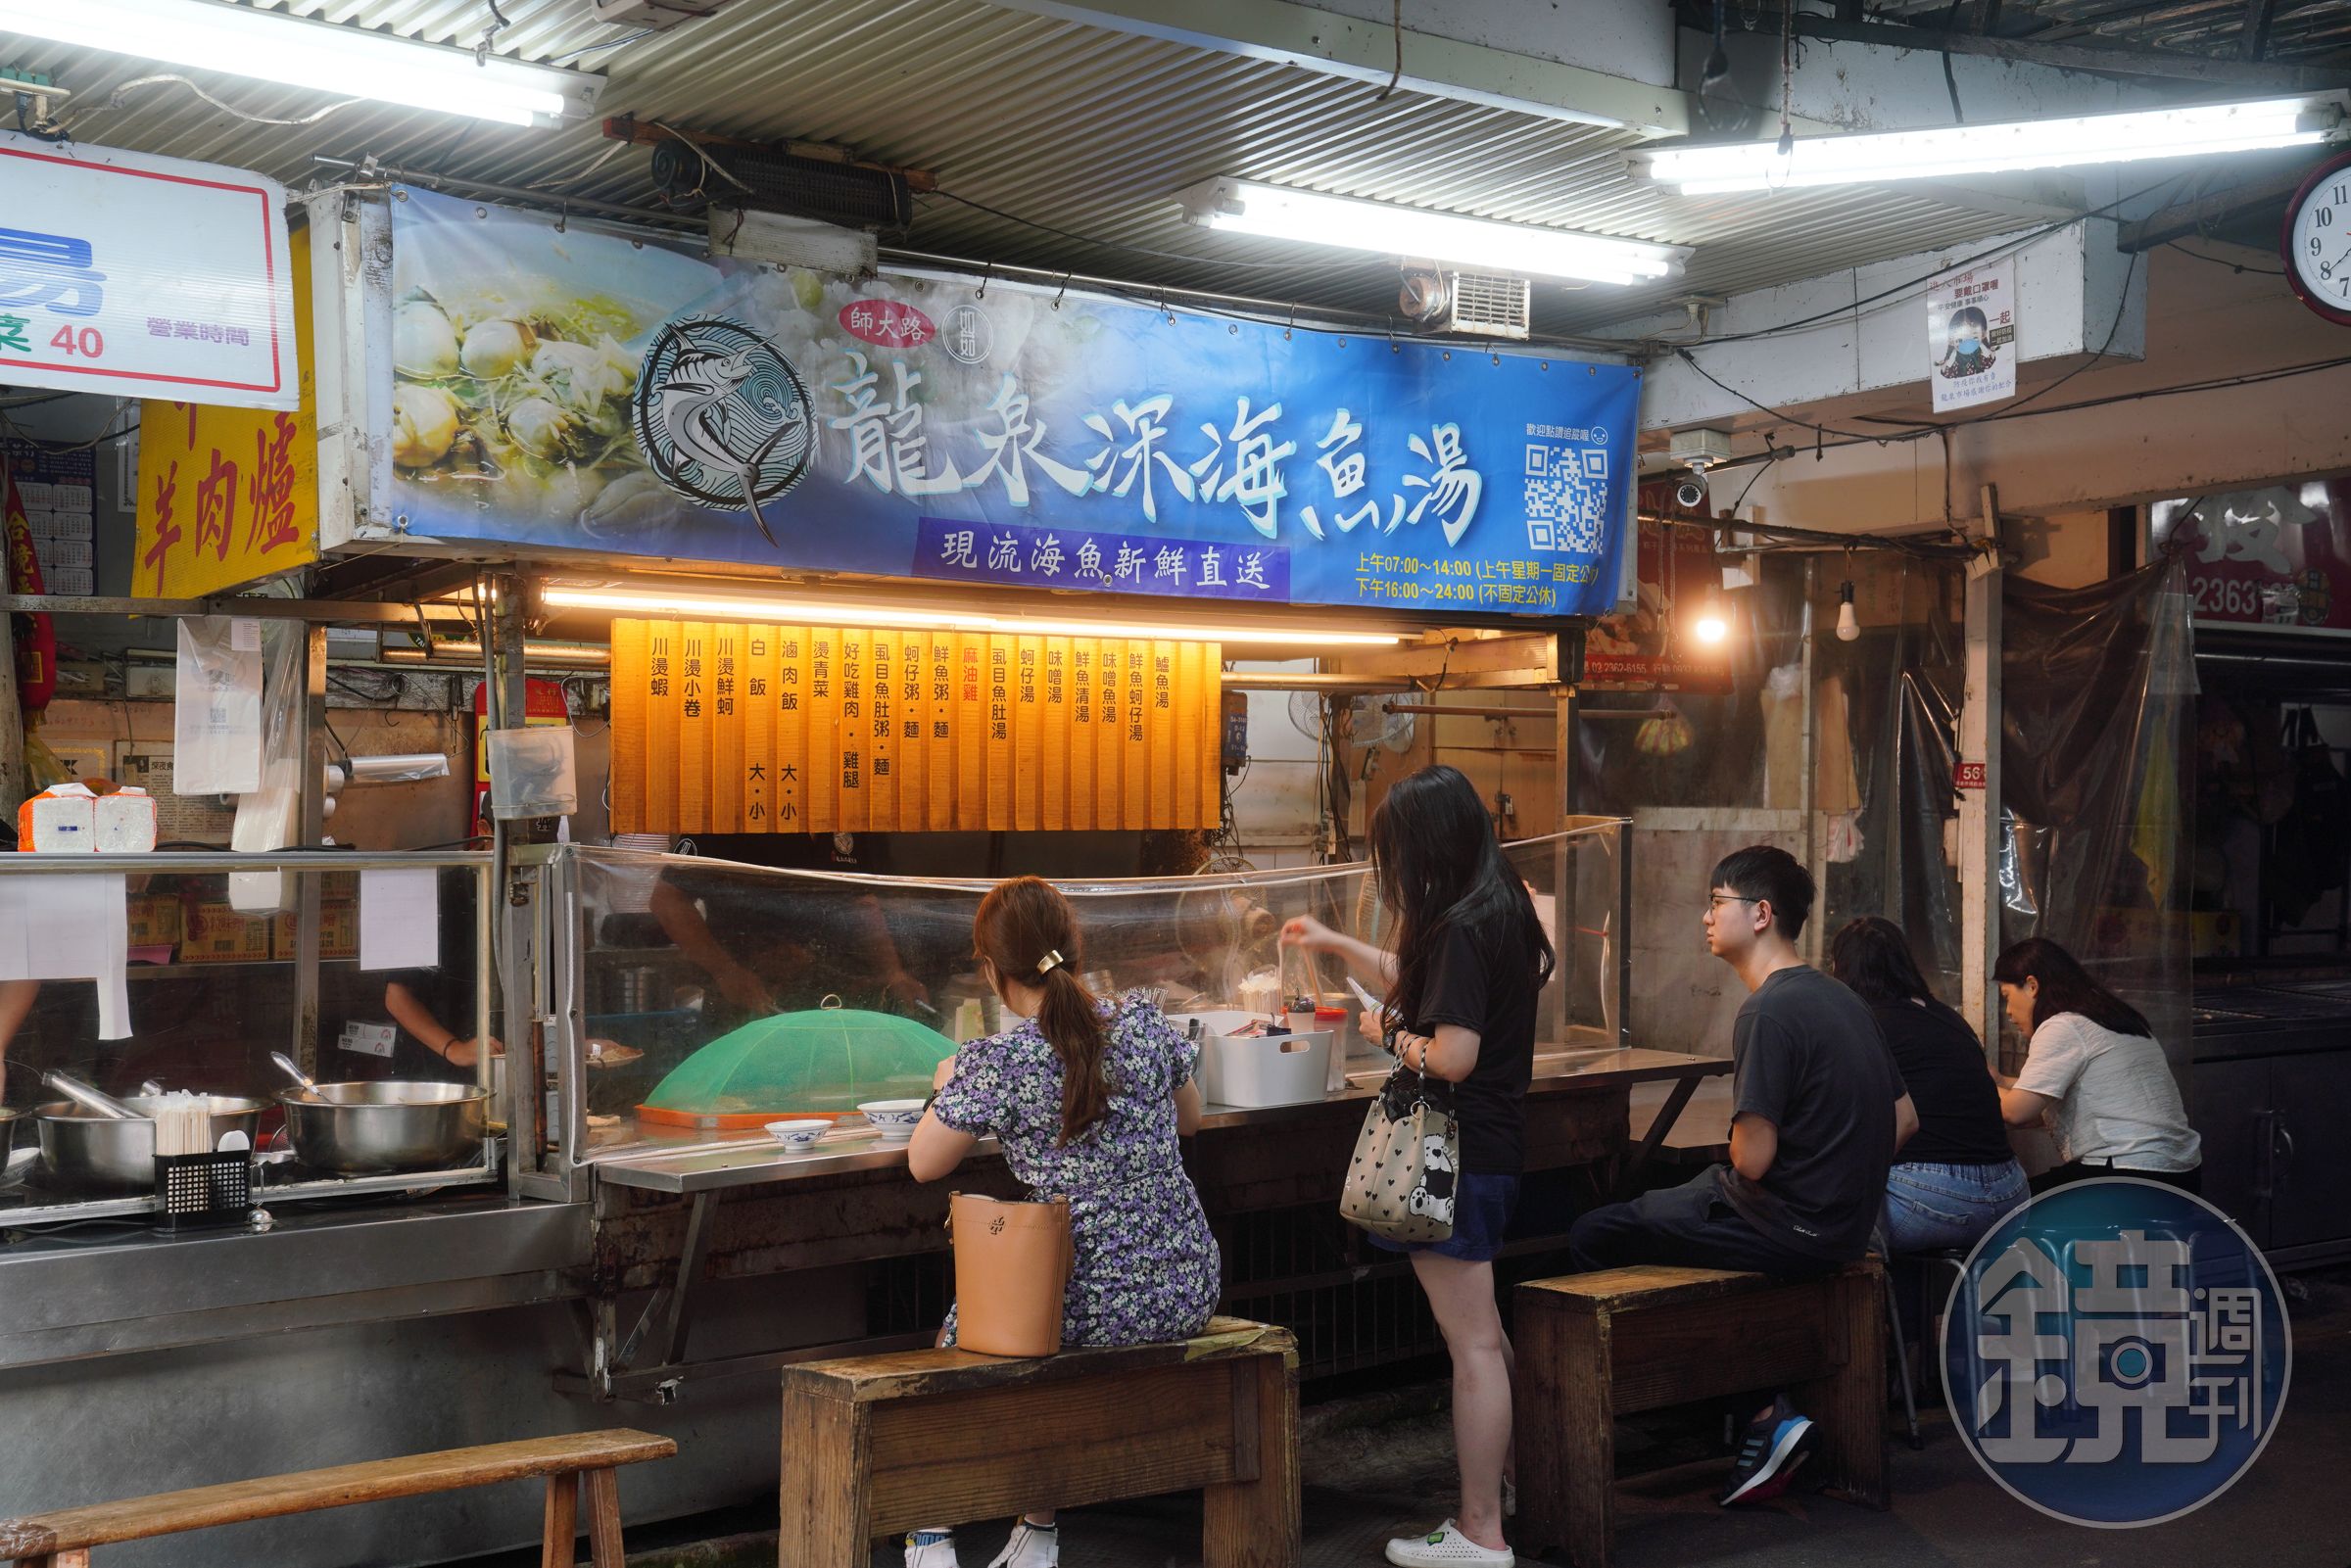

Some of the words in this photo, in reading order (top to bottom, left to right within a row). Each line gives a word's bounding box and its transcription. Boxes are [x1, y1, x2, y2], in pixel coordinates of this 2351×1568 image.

[2315, 207, 2332, 227] 10
[2333, 185, 2347, 205] 11
[2310, 237, 2322, 257] 9
[2320, 261, 2331, 281] 8
[2339, 277, 2350, 297] 7
[50, 324, 104, 358] 40
[147, 316, 250, 347] 營業時間
[850, 307, 926, 342] 師大路
[1989, 309, 2011, 326] 一起
[828, 348, 1484, 548] 龍泉深海魚湯
[1526, 423, 1590, 443] 歡迎點讚追蹤喔
[144, 411, 300, 598] 羊肉爐
[940, 530, 1271, 590] 現流海魚新鮮直送
[650, 638, 669, 697] 川燙蝦
[716, 638, 735, 716] 川燙鮮蚵
[749, 639, 766, 696] 白飯
[781, 640, 798, 711] 滷肉飯
[812, 641, 830, 698] 燙青菜
[963, 646, 979, 702] 麻油雞
[991, 648, 1007, 740] 虱目魚肚湯
[1020, 648, 1035, 704] 蚵仔湯
[1047, 649, 1063, 704] 味噌湯
[1075, 651, 1090, 724] 鮮魚清湯
[1102, 652, 1117, 724] 味噌魚湯
[1155, 656, 1170, 709] 鱸魚湯
[1128, 653, 1144, 742] 鮮魚蚵仔湯
[1963, 767, 1980, 780] 56
